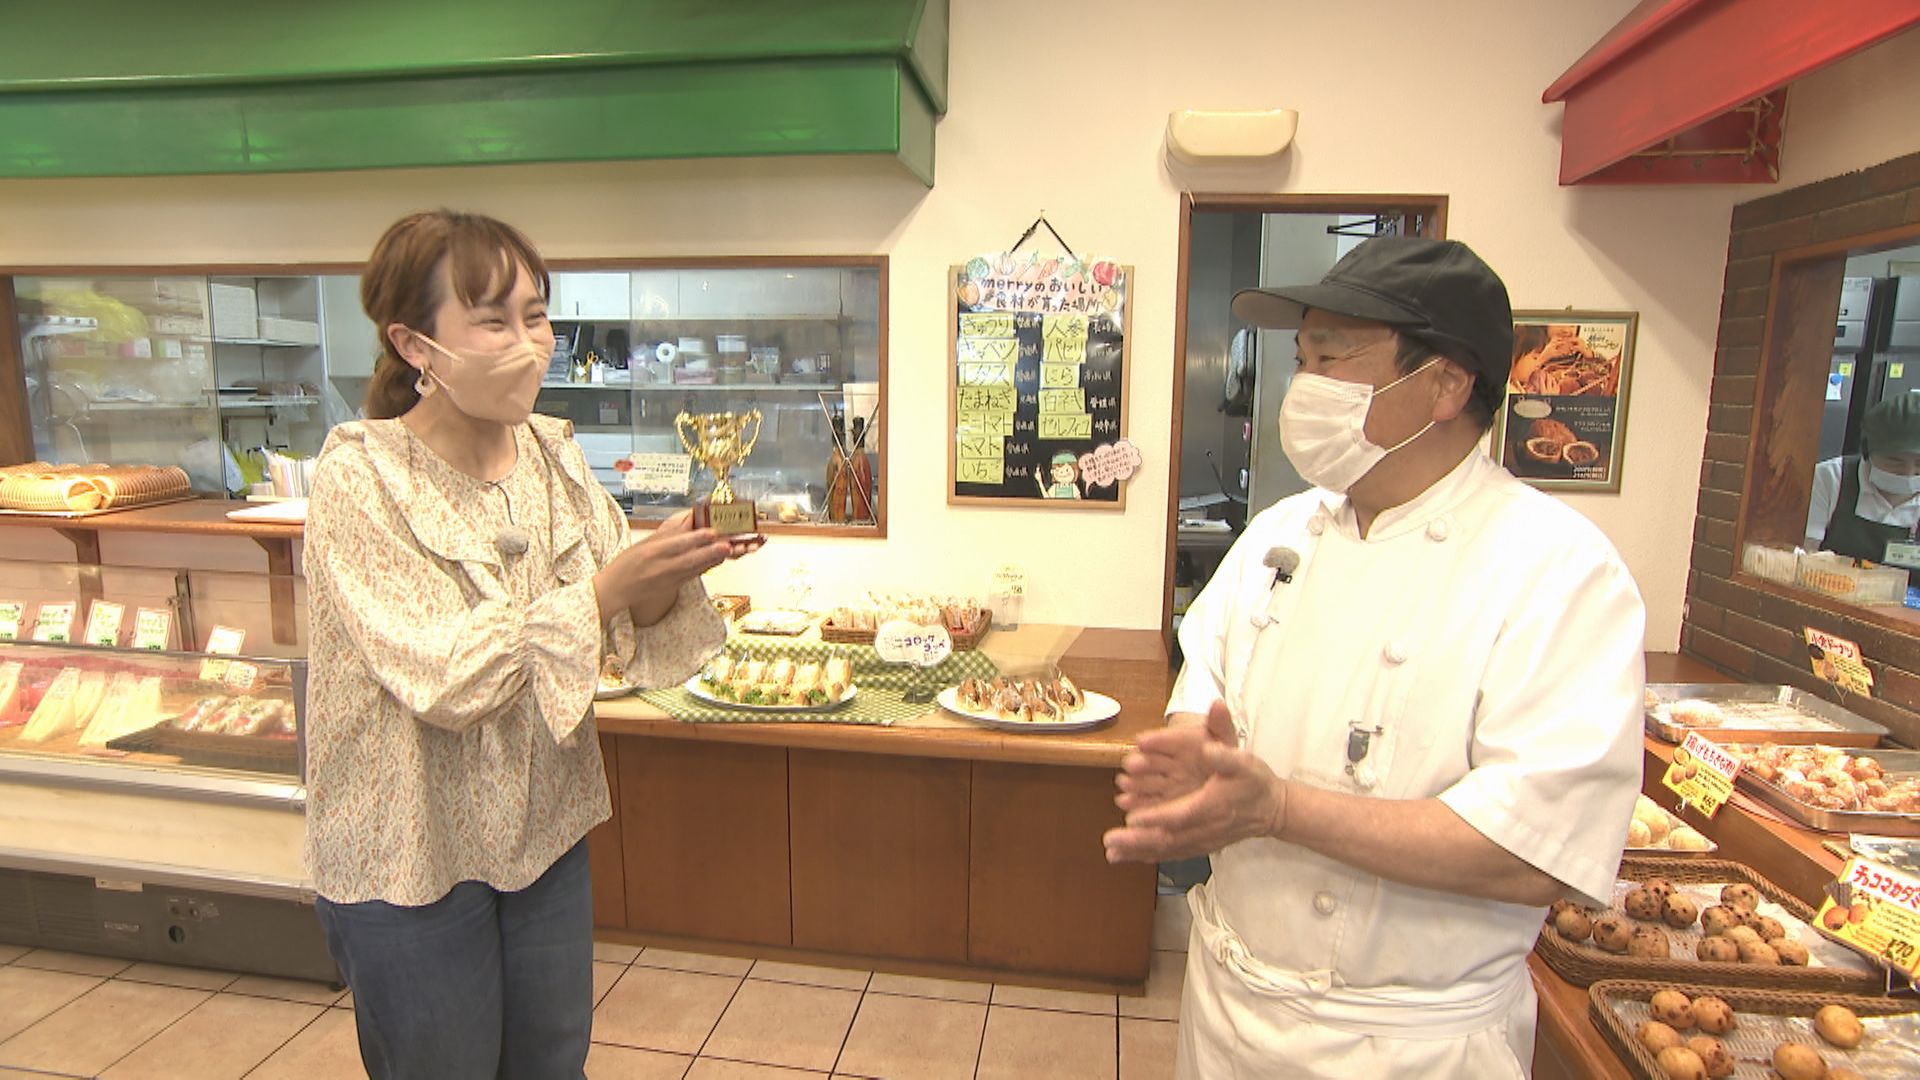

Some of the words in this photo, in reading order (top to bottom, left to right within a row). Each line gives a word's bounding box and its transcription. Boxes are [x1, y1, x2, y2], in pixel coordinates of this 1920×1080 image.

[982, 277, 1103, 294] merryのおいしい
[1046, 338, 1084, 362] パセリ
[959, 388, 1012, 411] たまねぎ
[960, 412, 1013, 434] ミニトマト
[960, 436, 1001, 458] トマト
[962, 461, 1000, 482] いちご
